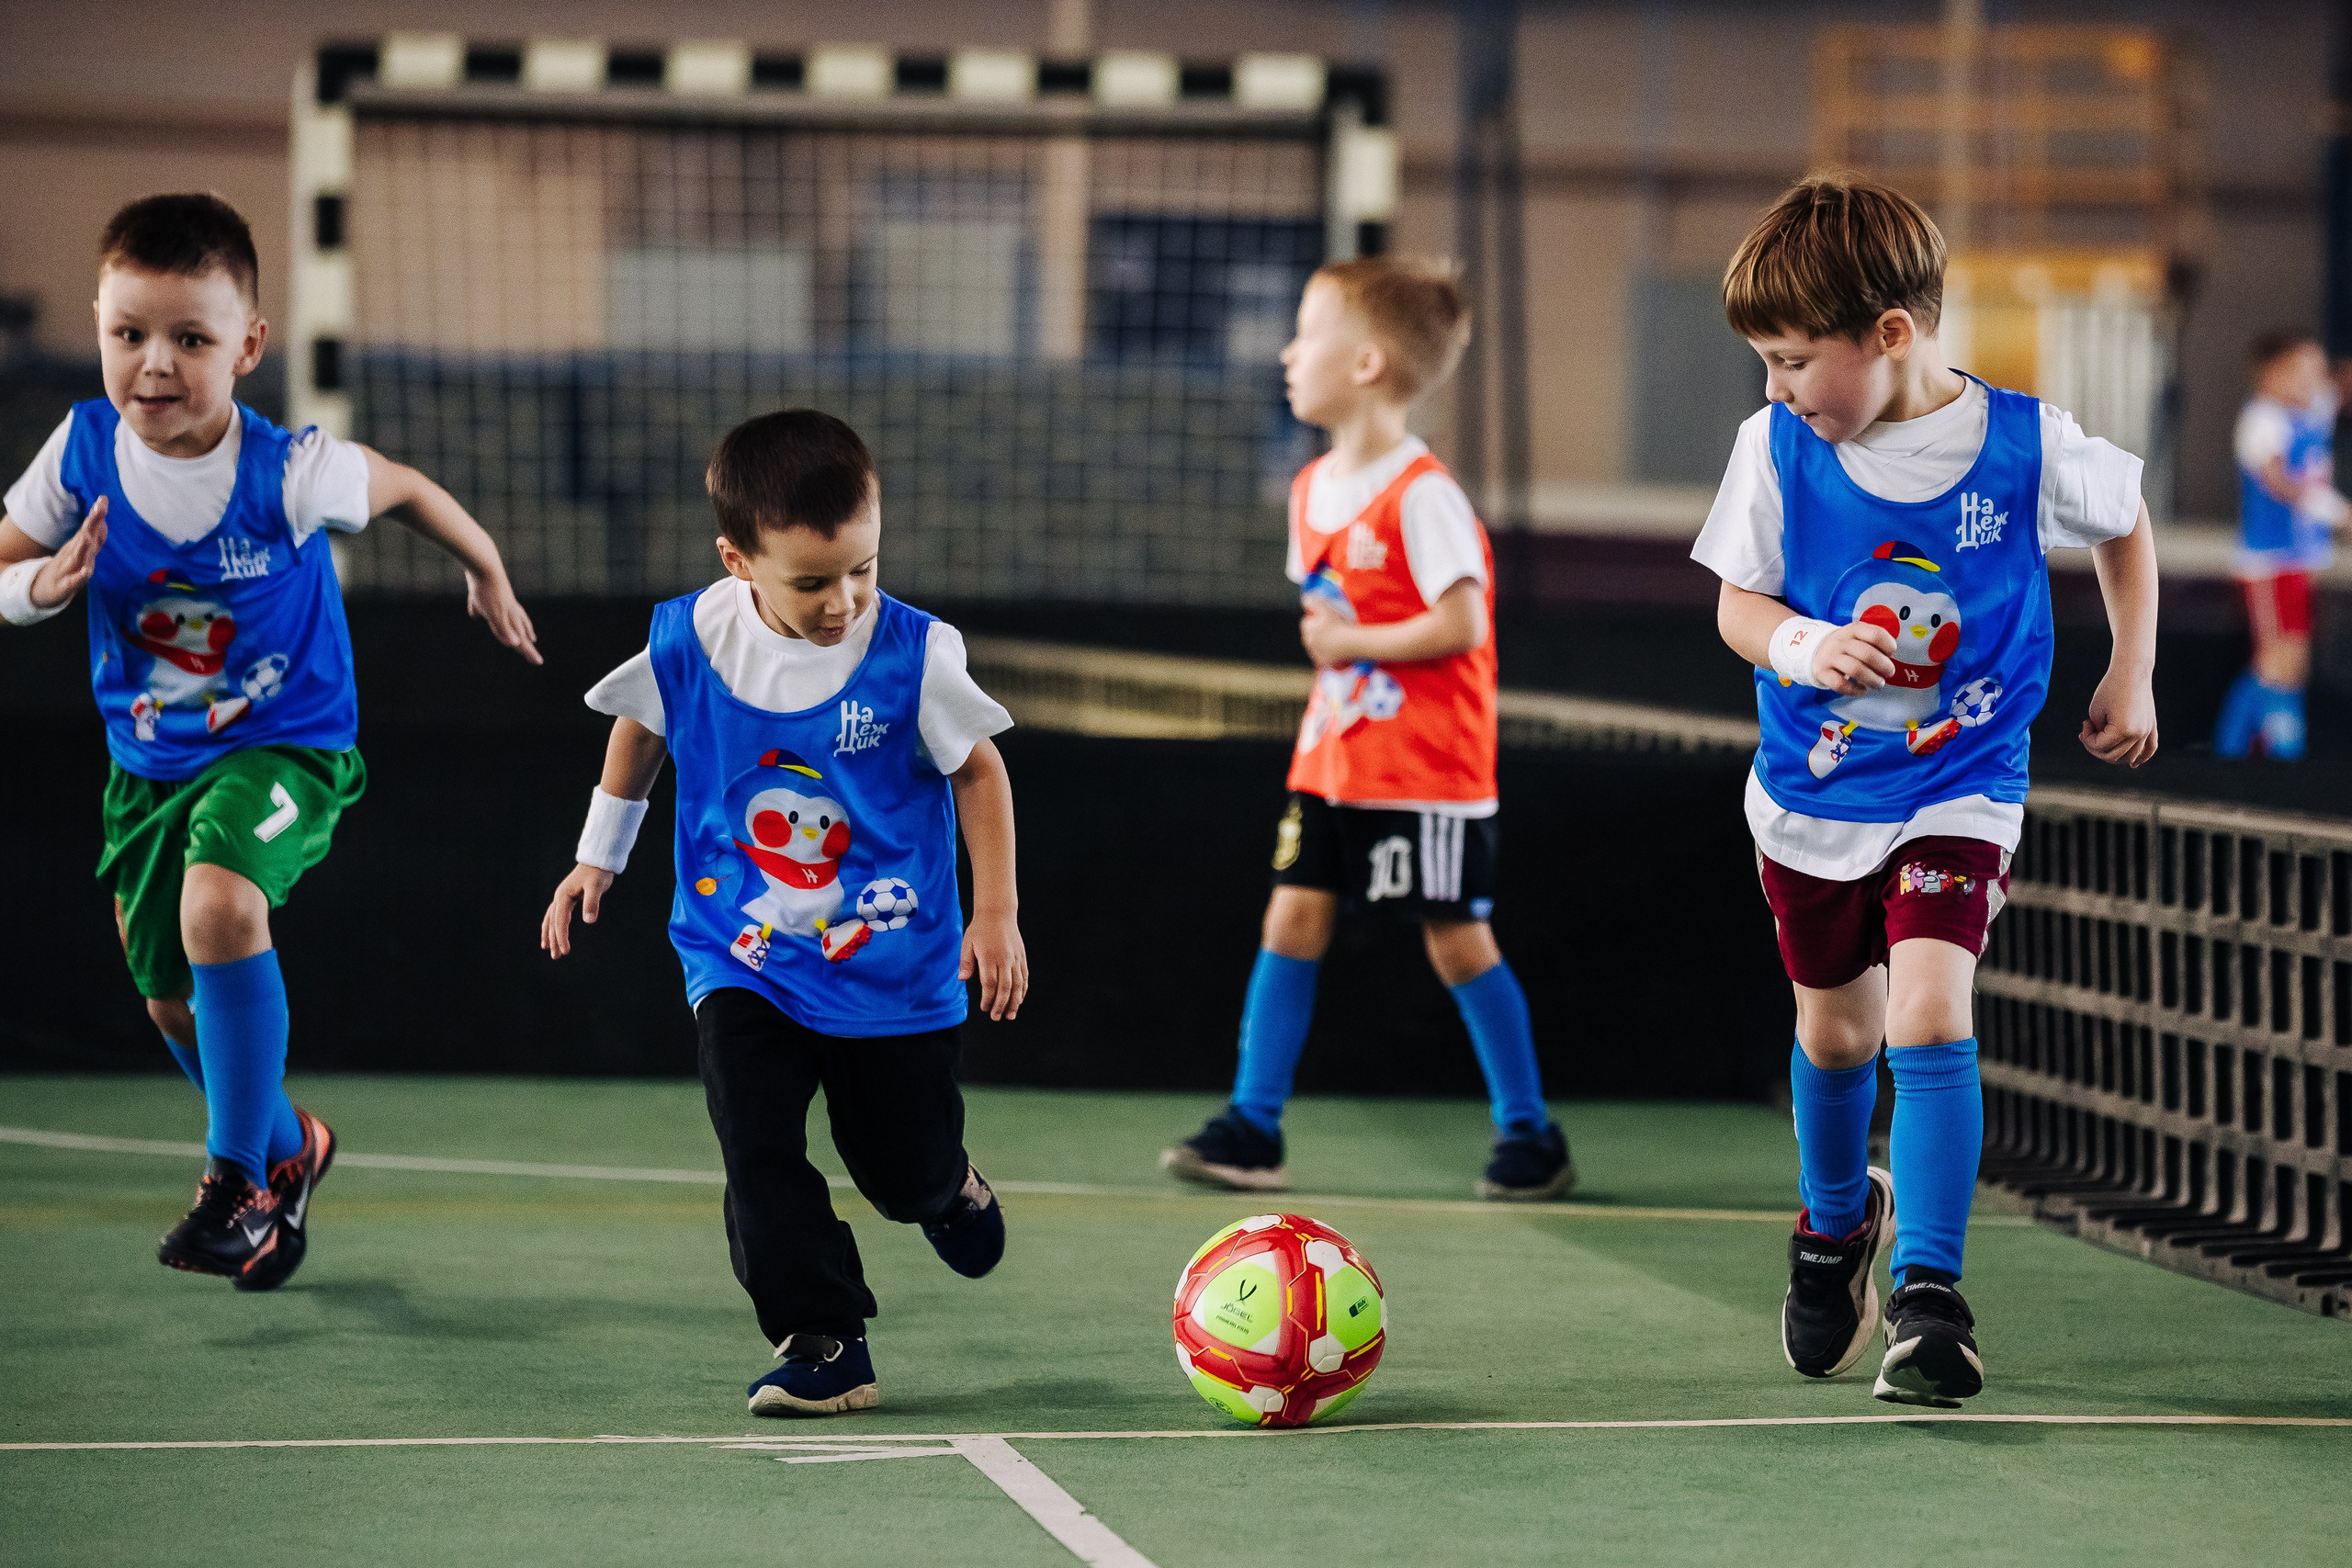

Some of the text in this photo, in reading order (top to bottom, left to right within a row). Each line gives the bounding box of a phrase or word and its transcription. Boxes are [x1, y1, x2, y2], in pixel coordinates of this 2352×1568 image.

[1790, 630, 1808, 647] 12
[254, 781, 300, 843] 7
[1367, 835, 1413, 902] 10
